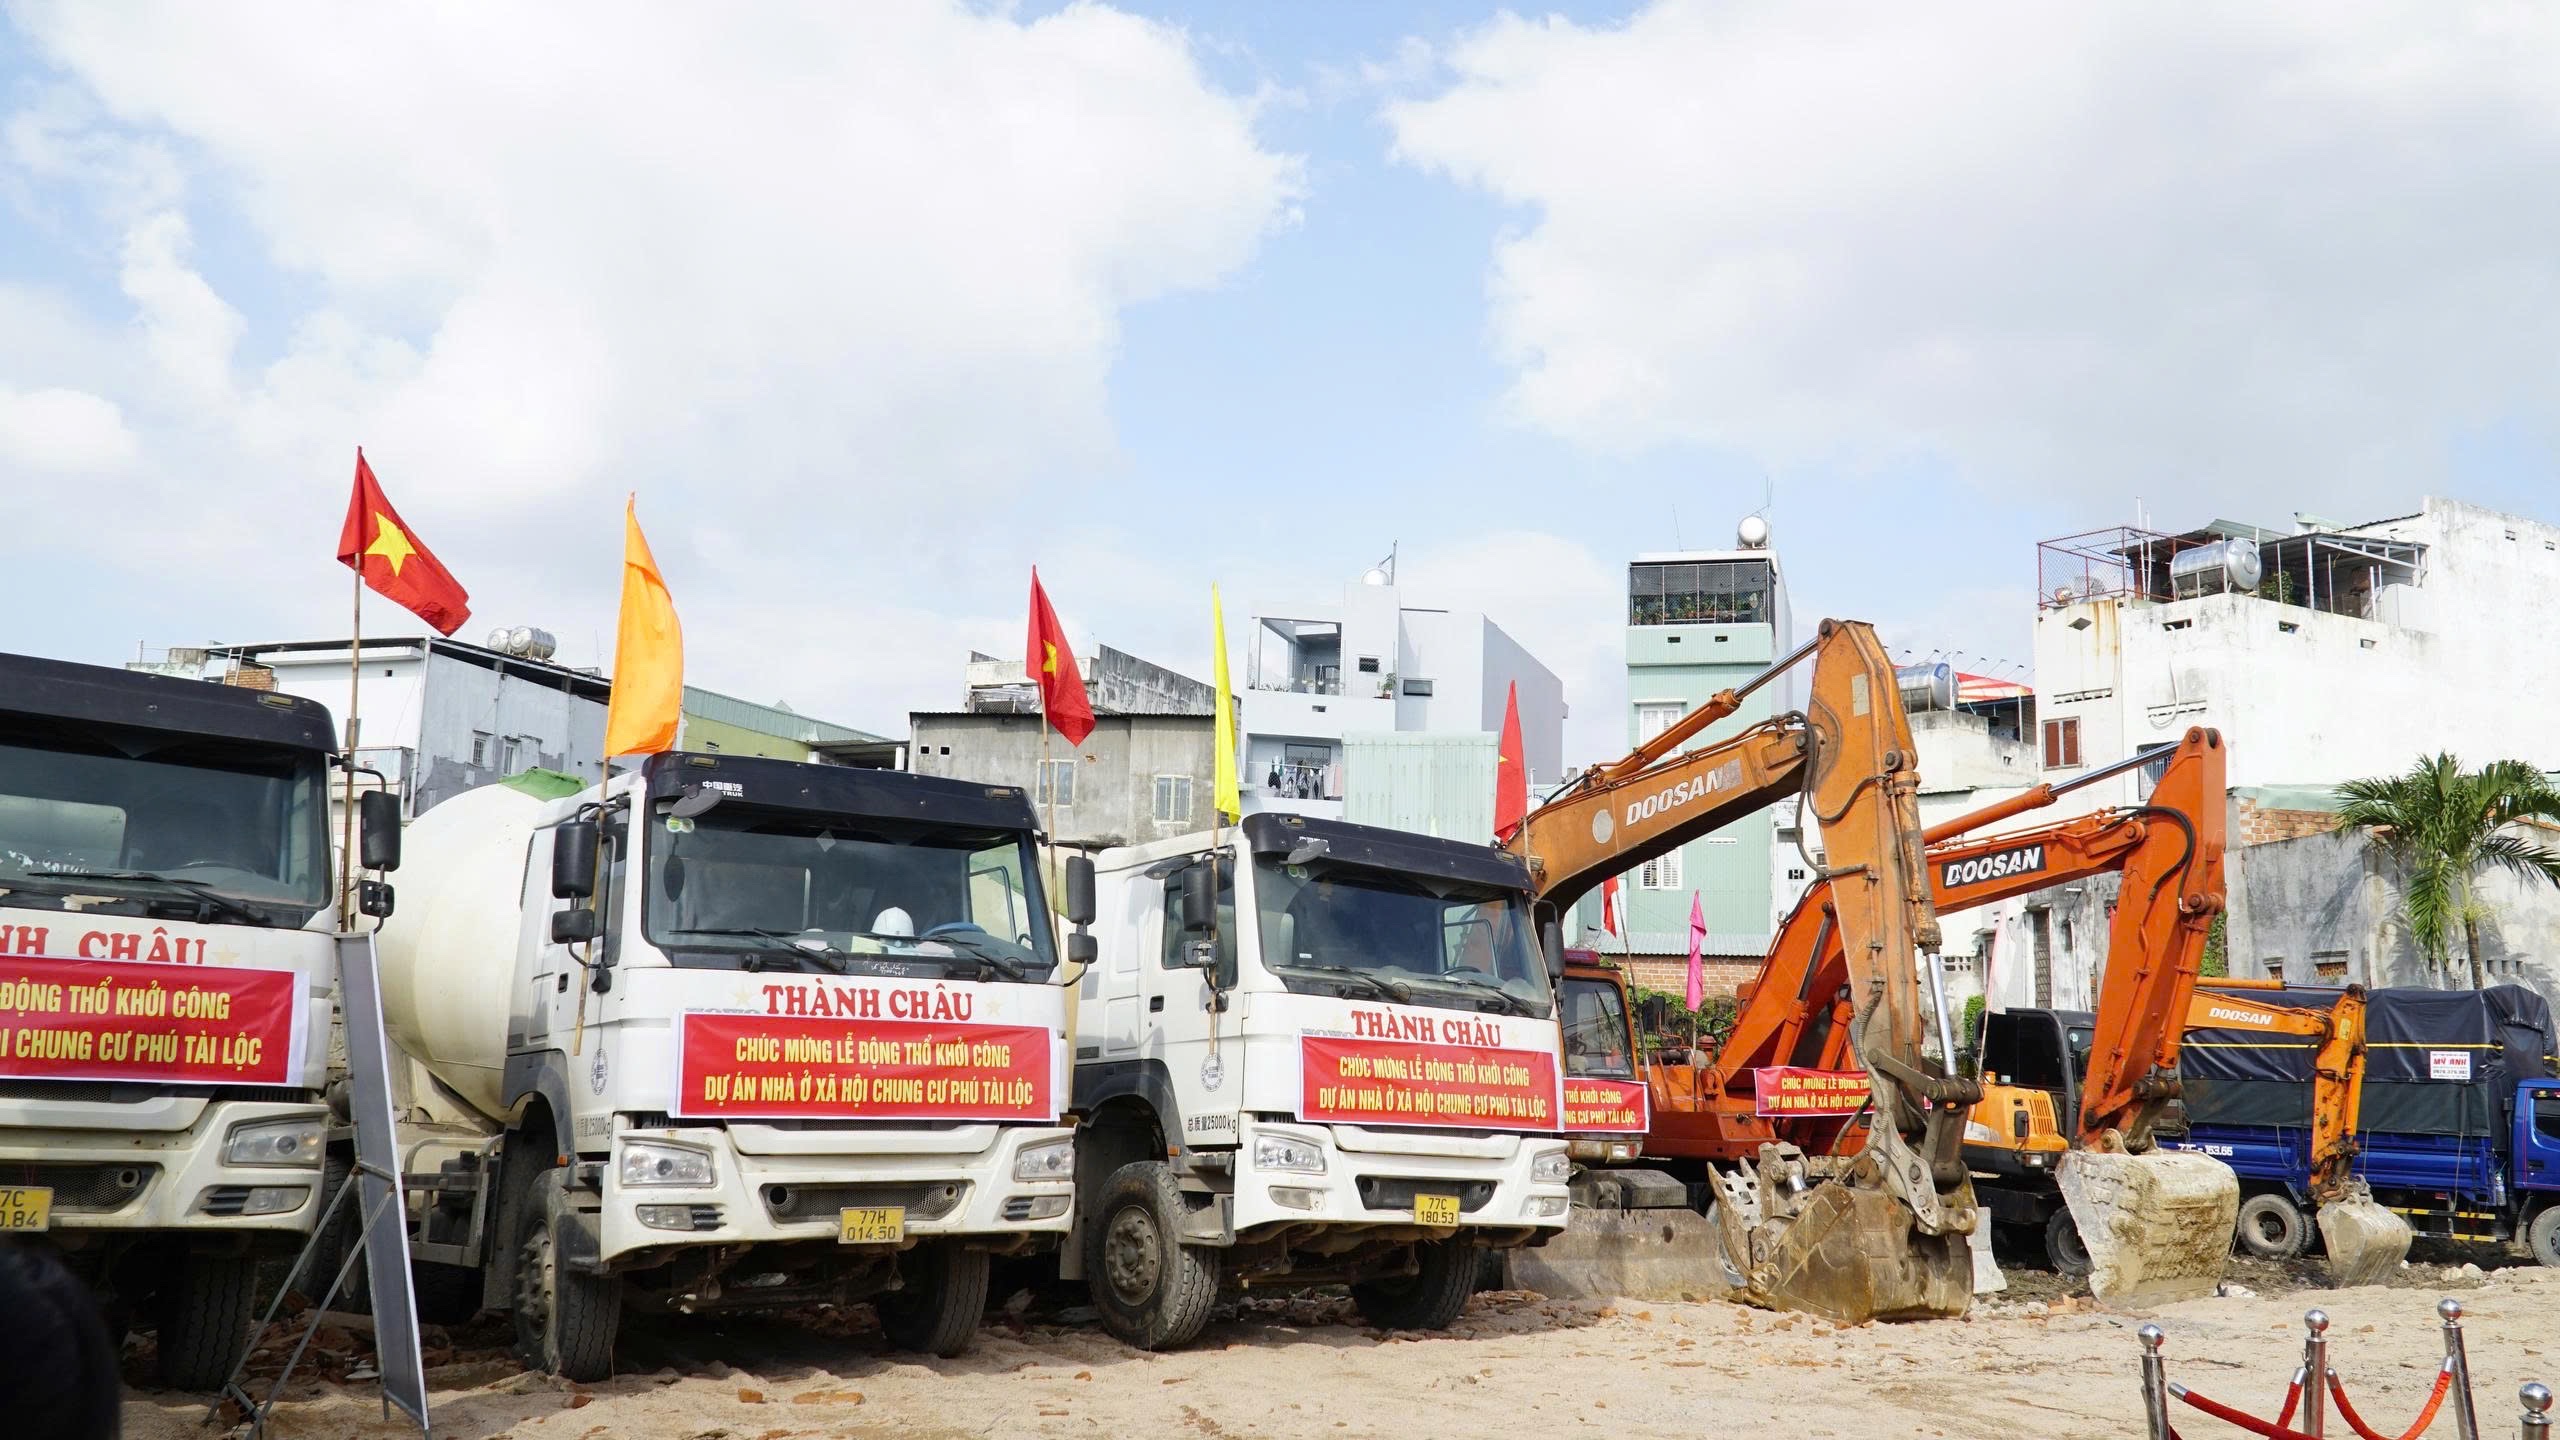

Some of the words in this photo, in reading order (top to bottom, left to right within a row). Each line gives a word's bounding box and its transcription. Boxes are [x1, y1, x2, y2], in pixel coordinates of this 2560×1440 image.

[1625, 768, 1724, 826] DOOSAN
[1945, 846, 2041, 886] DOOSAN
[0, 977, 62, 1017] ĐỘNG
[69, 976, 112, 1014] THỔ
[115, 980, 166, 1017] KHỞI
[172, 985, 230, 1019] CÔNG
[763, 978, 881, 1018] THÀNH
[889, 983, 973, 1021] CHÂU
[1351, 1006, 1436, 1042] THÀNH
[1442, 1015, 1501, 1047] CHÂU
[2208, 1007, 2273, 1025] DOOSAN
[16, 1029, 93, 1060] CHUNG
[98, 1030, 133, 1062] CƯ
[134, 1029, 178, 1063] PHÚ
[184, 1030, 217, 1064] TÀI
[222, 1031, 262, 1071] LỘC
[736, 1033, 780, 1062] CHÚC
[784, 1034, 833, 1064] MỪNG
[836, 1032, 855, 1064] LỄ
[859, 1036, 900, 1070] ĐỘNG
[904, 1034, 932, 1066] THỔ
[936, 1036, 968, 1067] KHỞI
[973, 1040, 1010, 1068] CÔNG
[1340, 1053, 1371, 1078] CHÚC
[1373, 1055, 1408, 1080] MỪNG
[1410, 1053, 1424, 1081] LỄ
[1425, 1057, 1454, 1086] ĐỘNG
[1456, 1057, 1476, 1084] THỔ
[1478, 1060, 1501, 1085] KHỞI
[1503, 1062, 1530, 1087] CÔNG
[1781, 1075, 1801, 1090] CHÚC
[704, 1074, 731, 1107] DỰ
[732, 1071, 757, 1101] ÁN
[760, 1071, 796, 1102] NHÀ
[800, 1069, 812, 1102] Ở
[815, 1073, 837, 1102] XÃ
[841, 1073, 868, 1108] HỘI
[872, 1078, 923, 1104] CHUNG
[927, 1078, 949, 1104] CƯ
[951, 1076, 979, 1105] PHÚ
[983, 1076, 1004, 1105] TÀI
[1007, 1077, 1034, 1110] LỘC
[1319, 1086, 1337, 1113] DỰ
[1338, 1084, 1356, 1110] ÁN
[1359, 1085, 1383, 1111] NHÀ
[1386, 1084, 1395, 1111] Ở
[1397, 1087, 1413, 1112] XÃ
[1415, 1088, 1434, 1117] HỘI
[1437, 1092, 1472, 1115] CHUNG
[1474, 1094, 1488, 1116] CƯ
[1489, 1093, 1510, 1117] PHÚ
[1511, 1093, 1527, 1117] TÀI
[1528, 1095, 1547, 1122] LỘC
[1565, 1085, 1579, 1104] THỔ
[1580, 1086, 1599, 1104] KHỞI
[1600, 1089, 1622, 1104] CÔNG
[1768, 1094, 1780, 1111] DỰ
[1781, 1093, 1792, 1108] ÁN
[1794, 1093, 1810, 1108] NHÀ
[1818, 1094, 1829, 1108] XÃ
[1830, 1093, 1842, 1110] HỘI
[1578, 1109, 1589, 1124] CƯ
[1590, 1108, 1606, 1124] PHÚ
[1608, 1107, 1620, 1124] TÀI
[1621, 1107, 1636, 1127] LỘC
[860, 1210, 887, 1225] 77H
[1420, 1211, 1454, 1225] 180.53
[1428, 1197, 1447, 1211] 77C
[847, 1226, 897, 1241] 014.50
